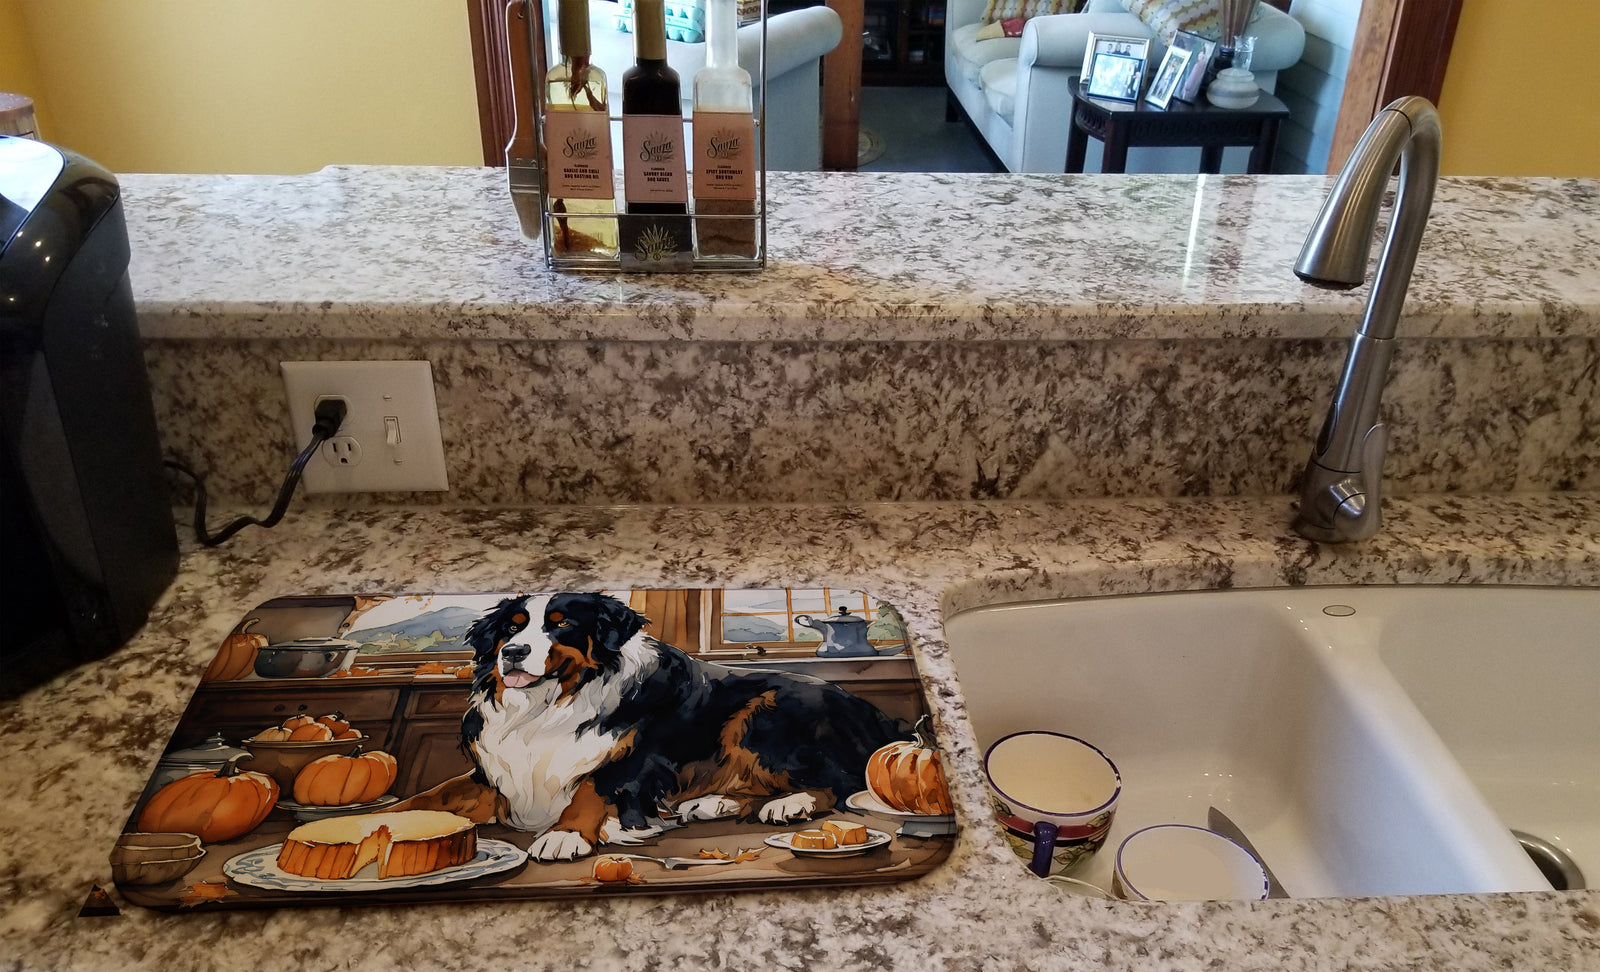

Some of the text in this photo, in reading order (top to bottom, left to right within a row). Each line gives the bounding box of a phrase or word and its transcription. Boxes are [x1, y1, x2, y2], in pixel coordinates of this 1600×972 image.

[563, 136, 597, 158] Sauza
[640, 140, 673, 162] Sauza
[707, 137, 740, 159] Sauza
